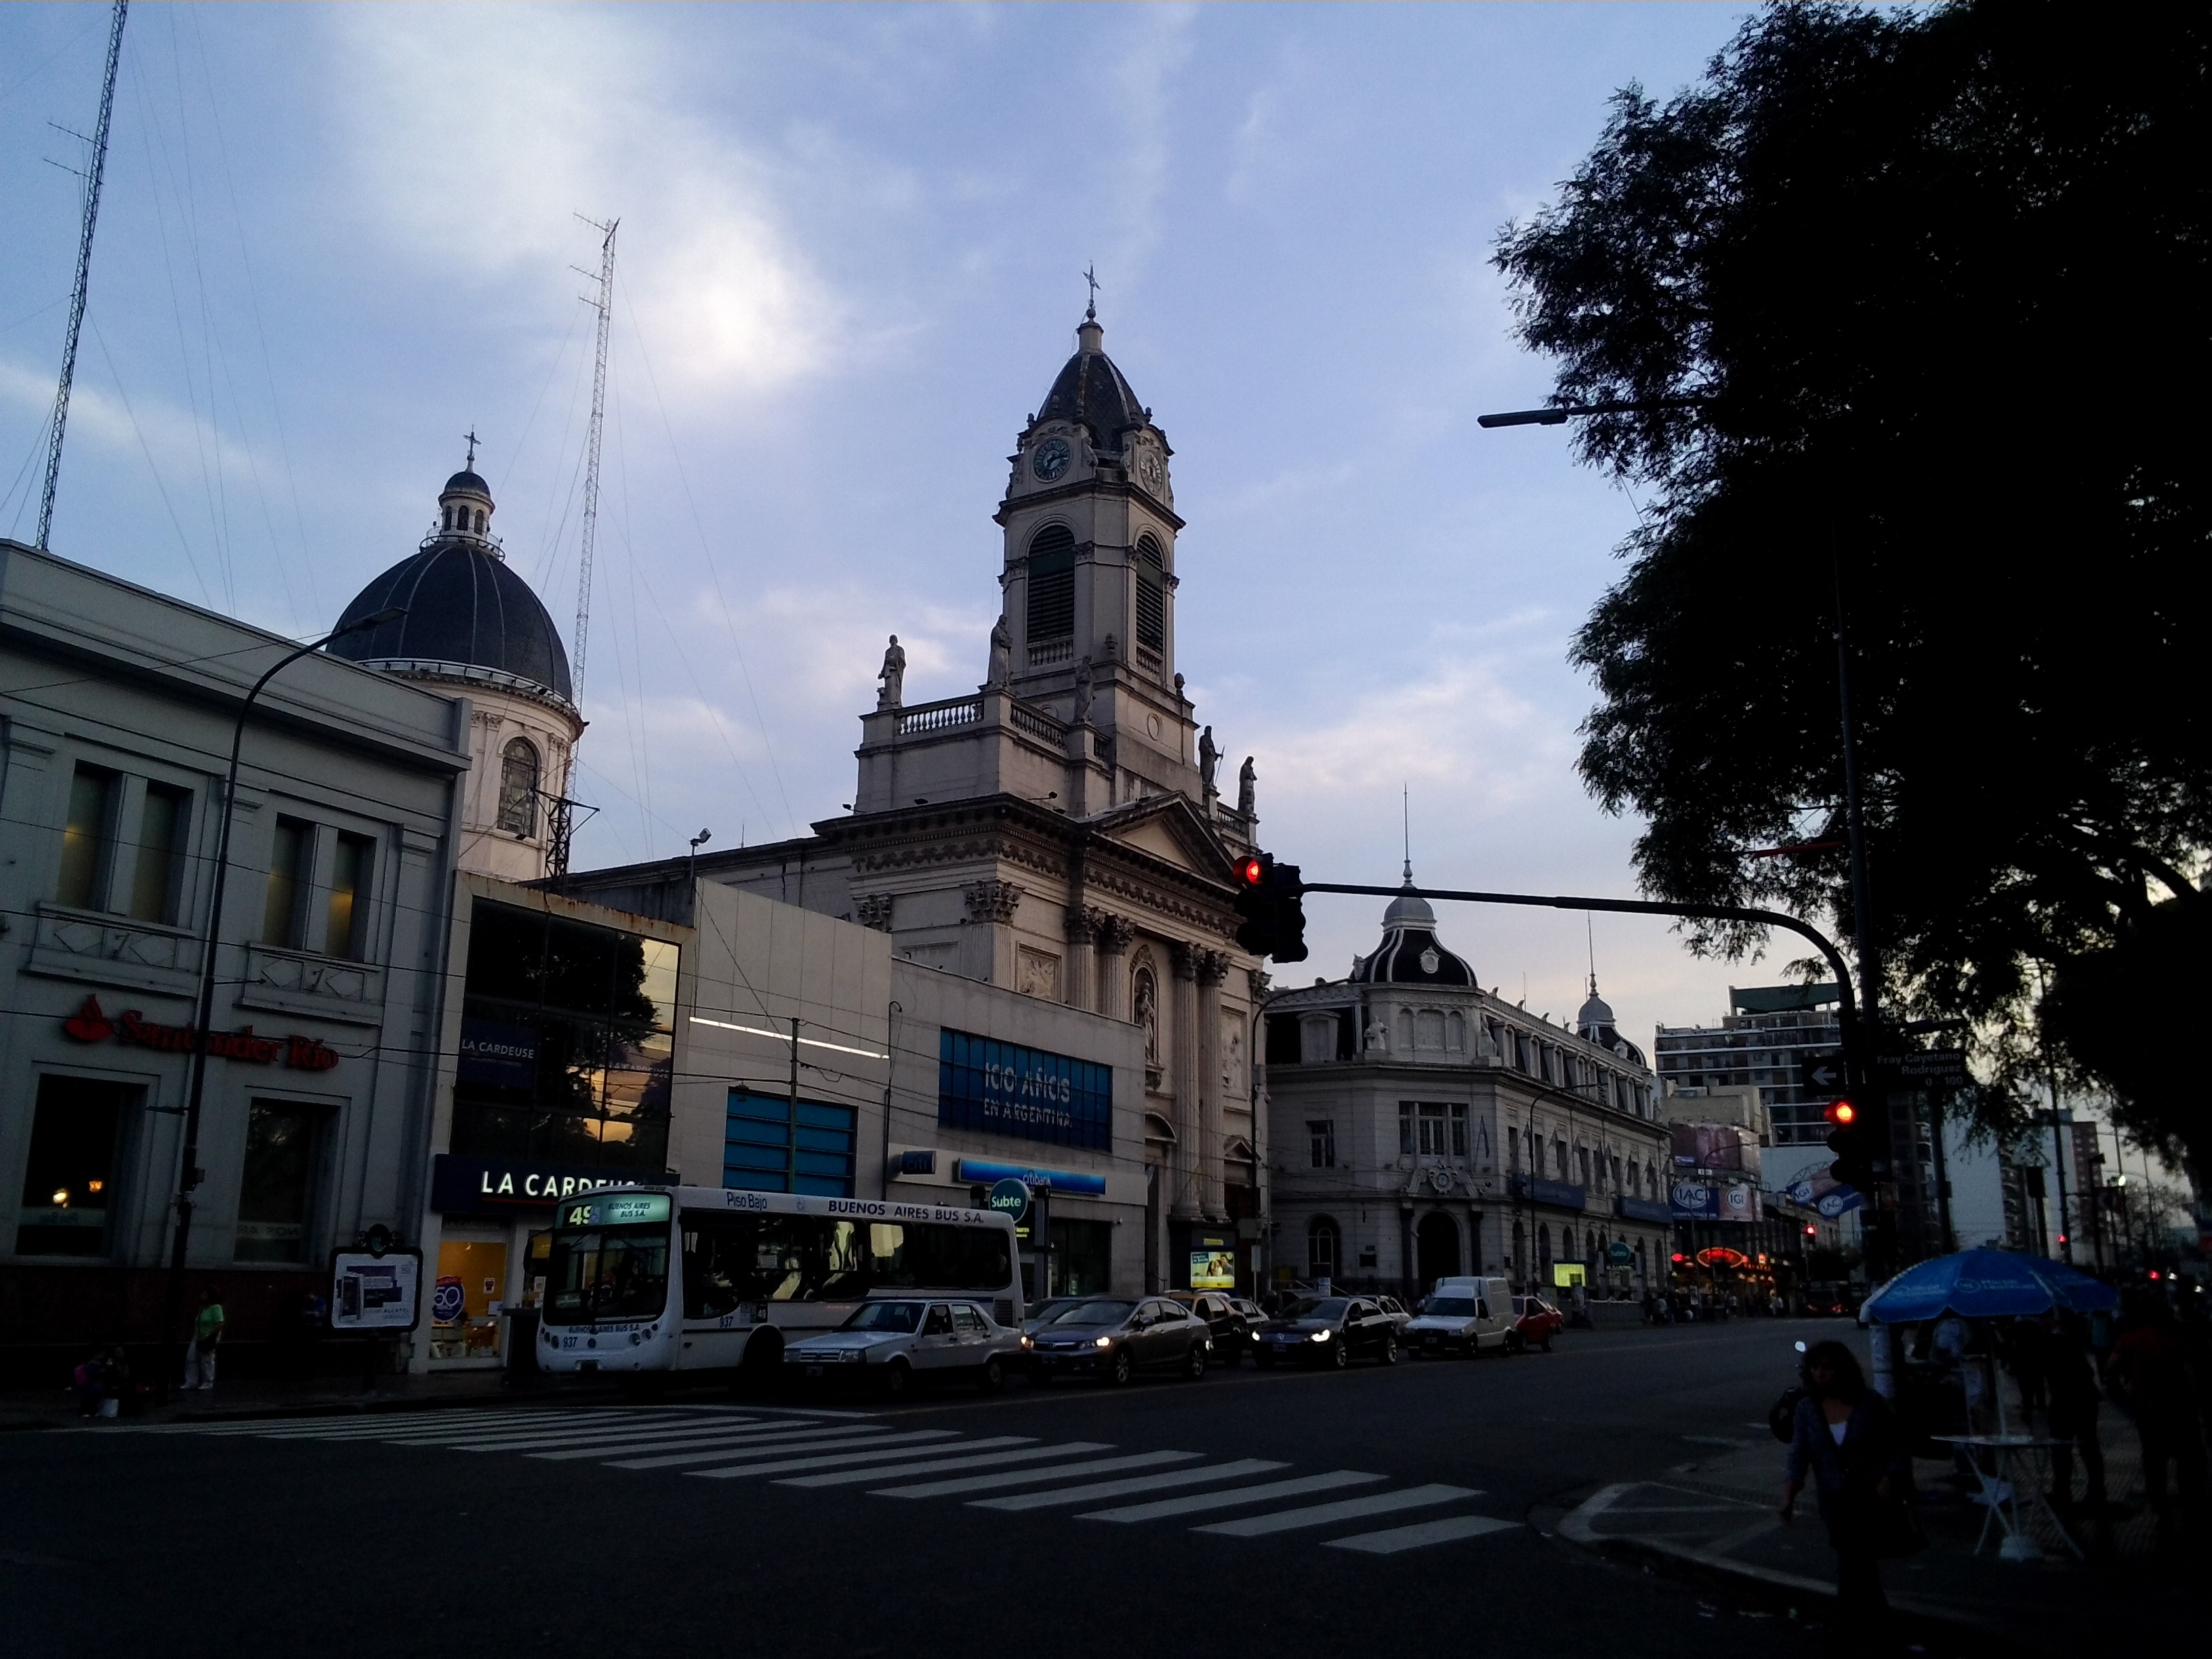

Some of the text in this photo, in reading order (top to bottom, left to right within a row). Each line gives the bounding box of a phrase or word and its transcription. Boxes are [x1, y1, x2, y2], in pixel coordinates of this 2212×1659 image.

[121, 1010, 339, 1069] Santnder Río
[462, 1039, 535, 1059] LA CARDEUSE
[1877, 1052, 1961, 1065] Fray Cayetano
[985, 1062, 1070, 1103] 100 AÑOS
[1925, 1077, 1933, 1086] 0
[1944, 1076, 1963, 1086] 100
[984, 1098, 1072, 1128] EN ARGENTINA
[906, 1158, 927, 1171] citi
[481, 1171, 514, 1195] LA
[726, 1191, 768, 1211] Piso Bajo
[991, 1195, 1022, 1208] Subte
[1679, 1188, 1704, 1202] IAC
[569, 1205, 592, 1226] 49
[828, 1200, 985, 1224] BUENOS AIRES BUS S.A.
[719, 1316, 734, 1328] 937
[563, 1336, 578, 1348] 937
